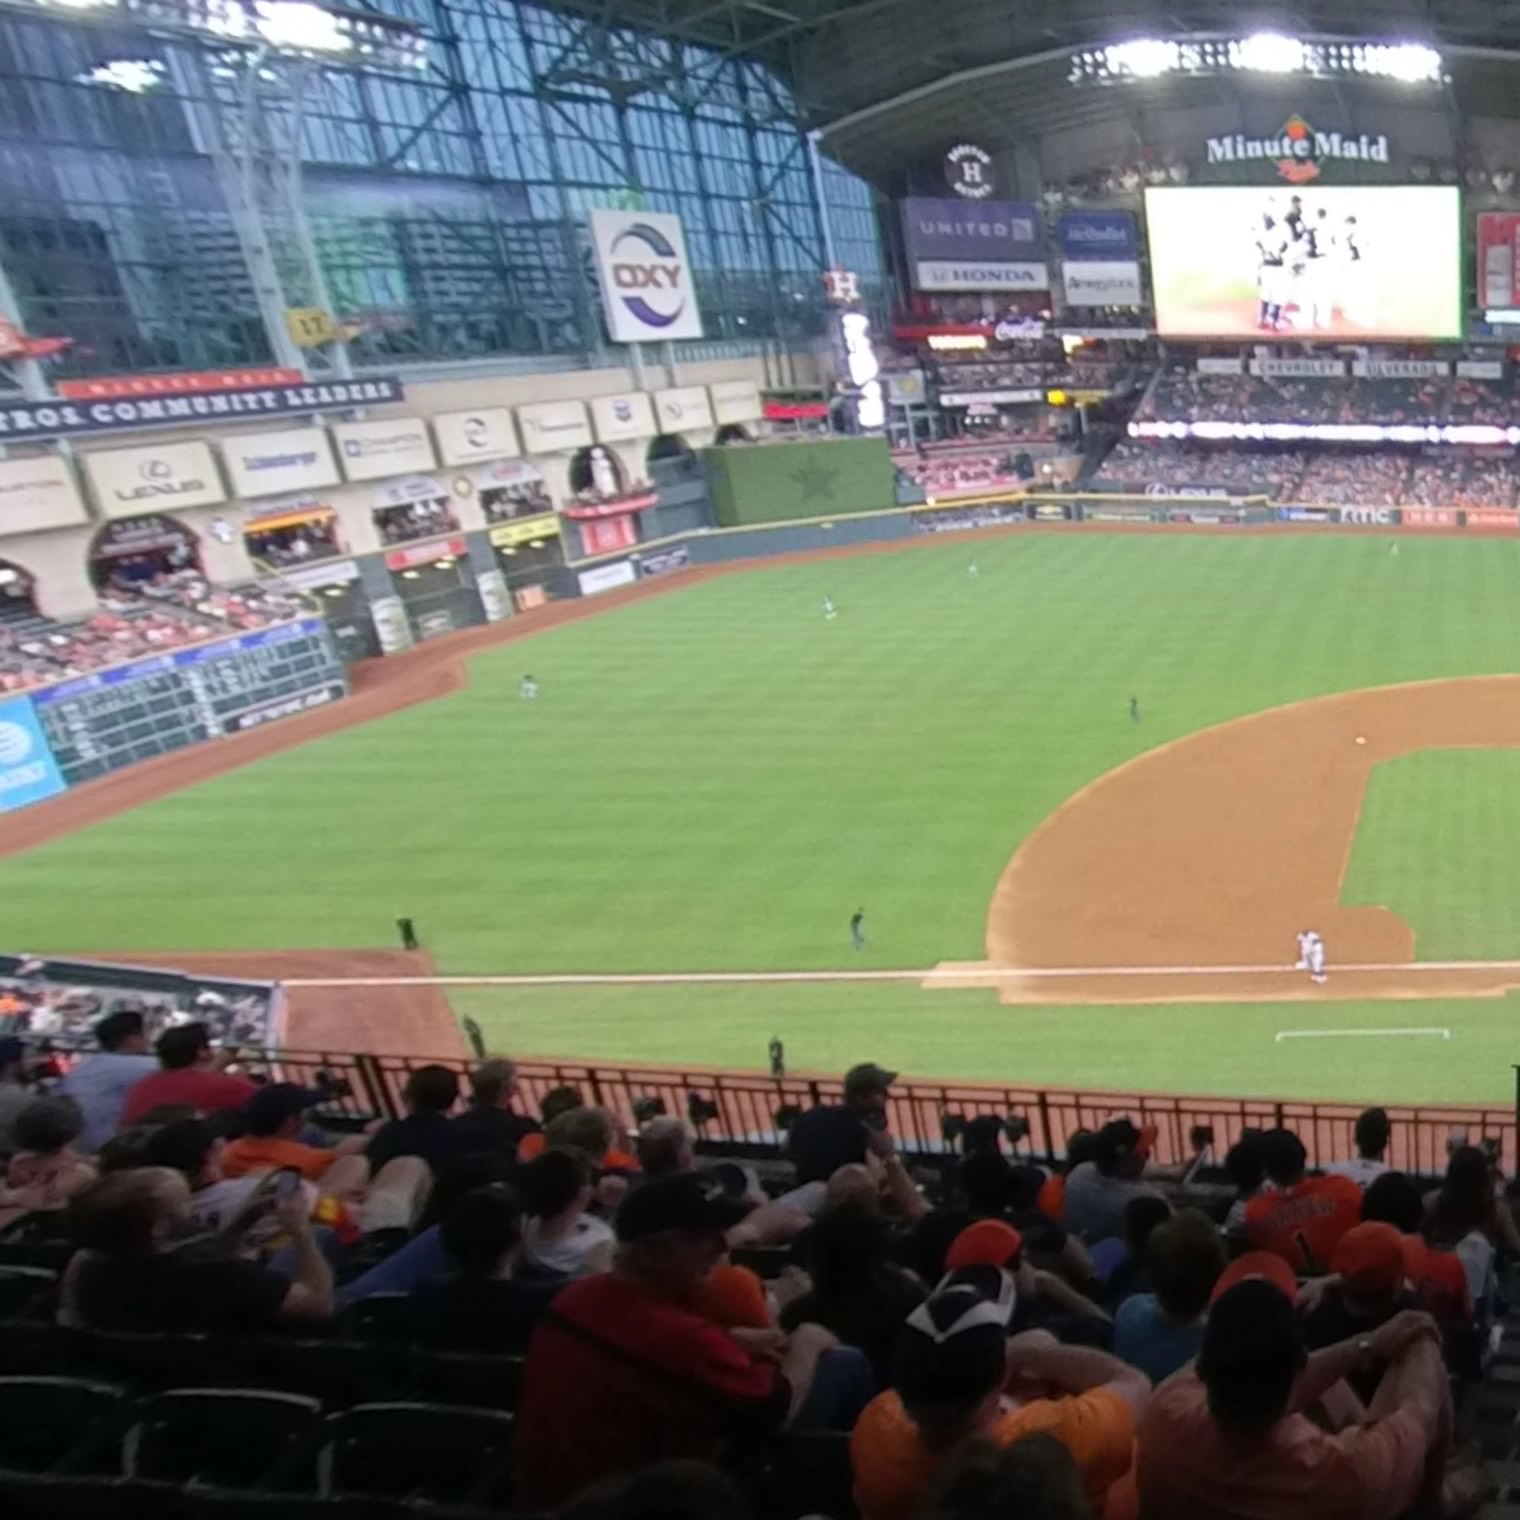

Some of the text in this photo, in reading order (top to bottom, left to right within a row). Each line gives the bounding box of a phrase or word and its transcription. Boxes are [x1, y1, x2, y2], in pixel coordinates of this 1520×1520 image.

[1206, 131, 1389, 163] Minute Maid
[962, 161, 982, 182] H
[919, 220, 1008, 237] UNITED
[612, 263, 681, 289] OXY
[833, 271, 860, 298] H
[952, 268, 1036, 283] HONDA
[1257, 361, 1336, 376] CHEVROLET
[90, 390, 279, 423] COMMUNITY
[284, 381, 392, 407] LEADERS
[114, 479, 206, 501] LEXUS
